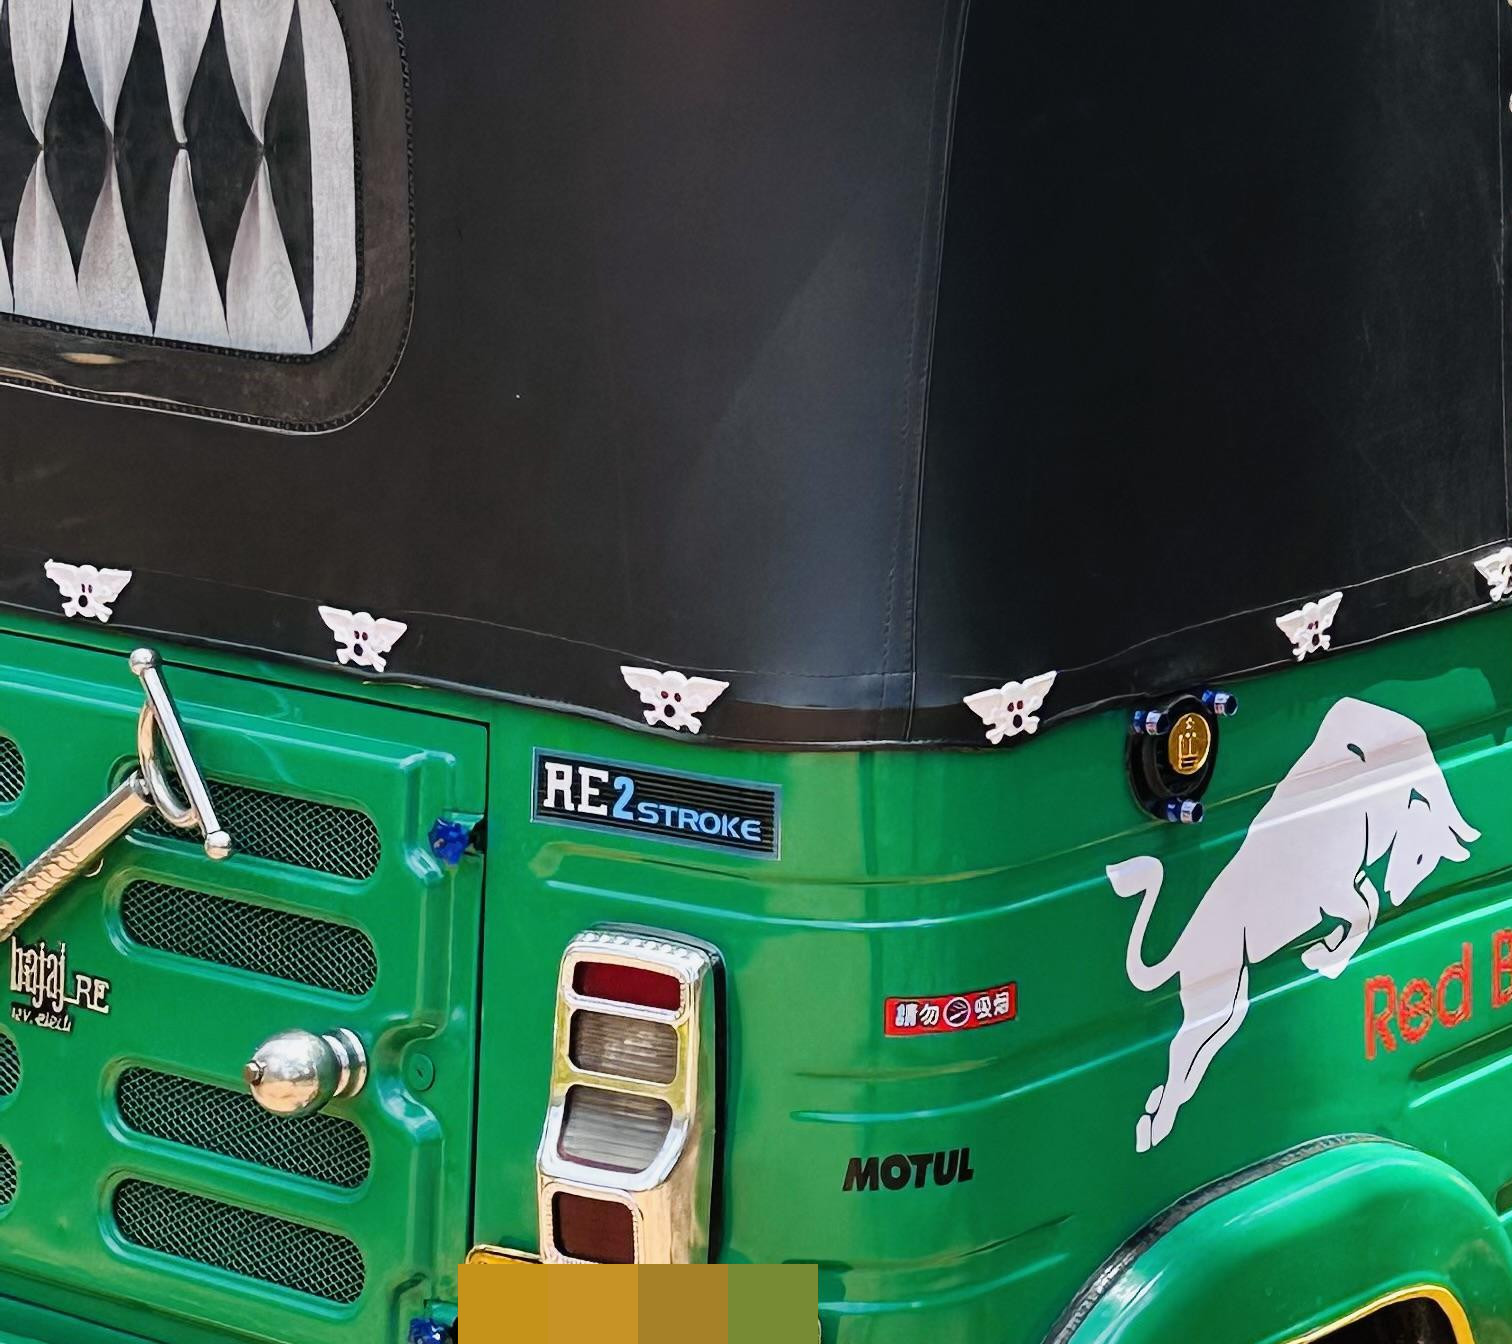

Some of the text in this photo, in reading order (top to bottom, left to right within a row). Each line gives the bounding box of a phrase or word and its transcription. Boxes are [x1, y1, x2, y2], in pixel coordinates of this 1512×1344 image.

[637, 802, 762, 842] STROKE
[1364, 942, 1473, 1060] Red
[842, 1148, 974, 1192] MOTUL
